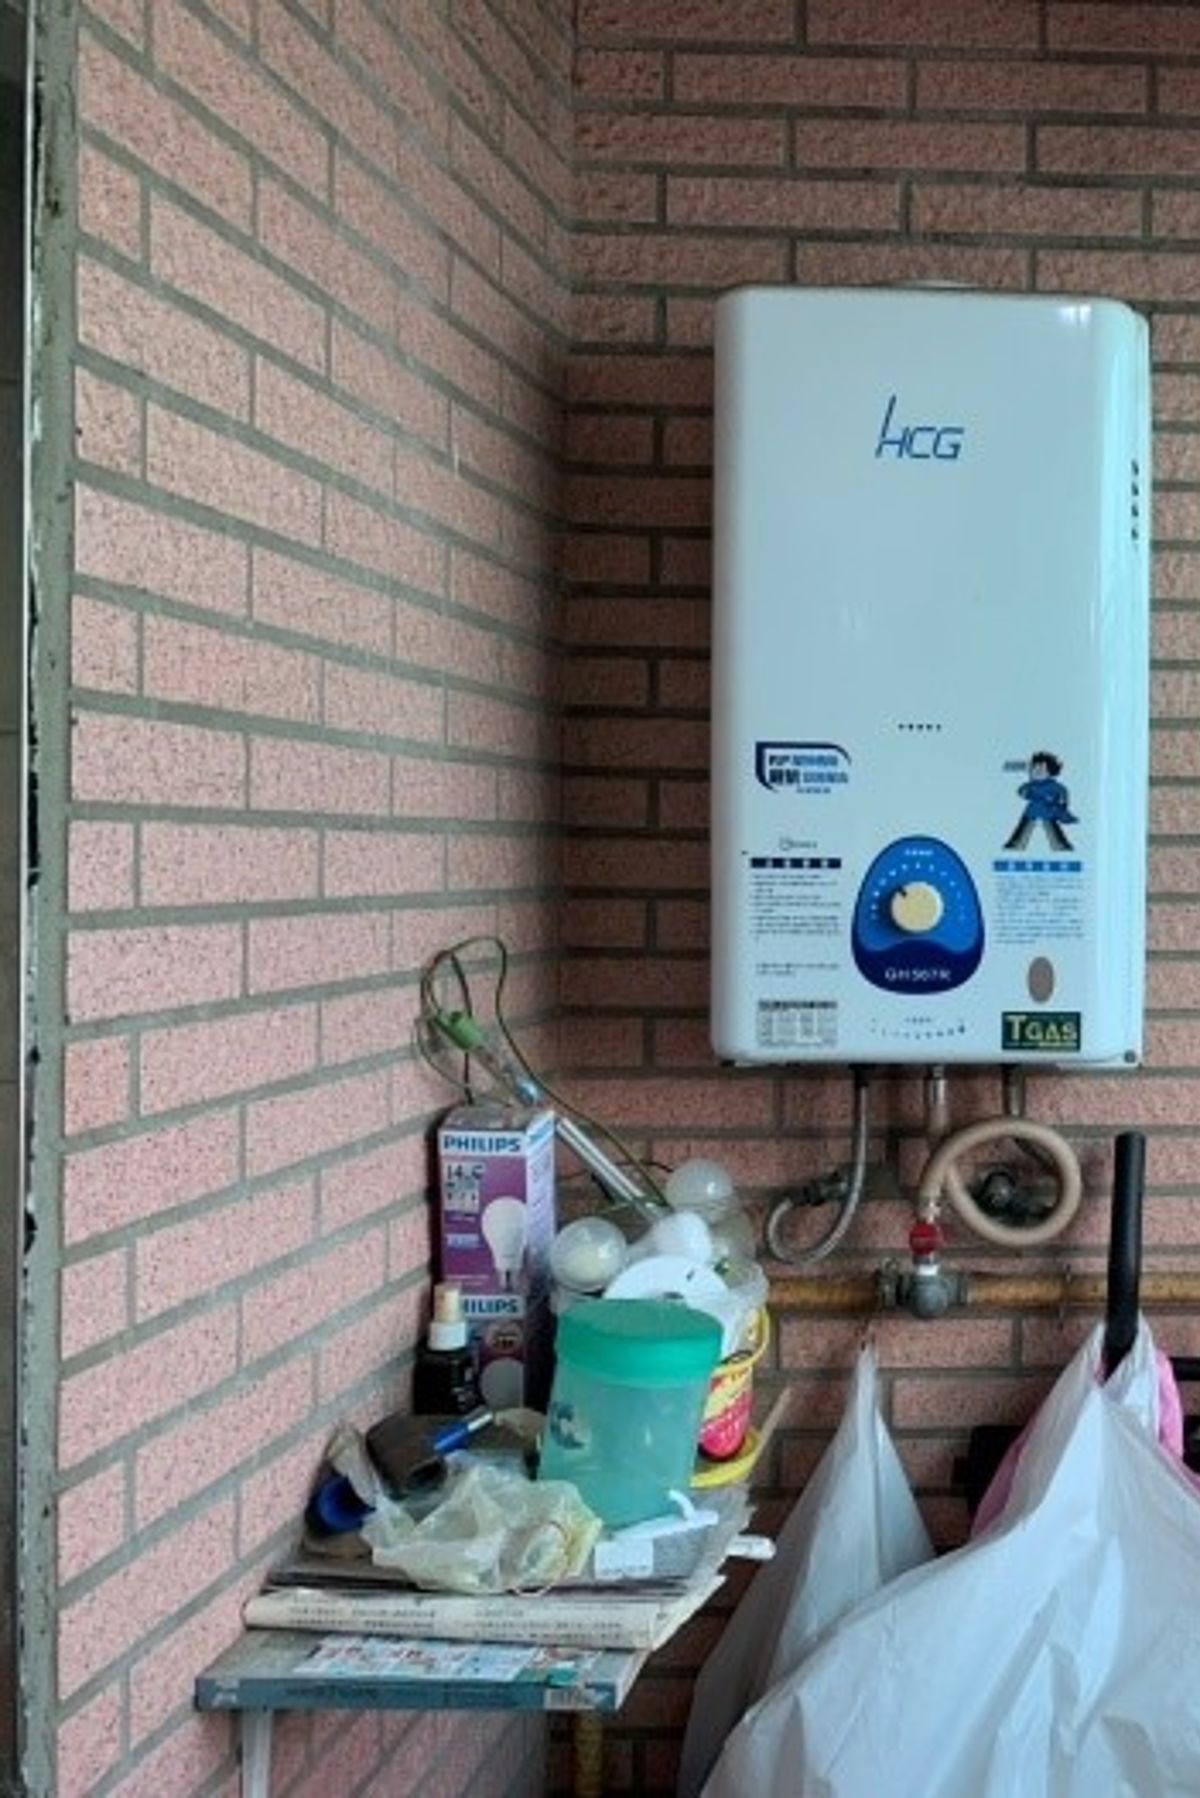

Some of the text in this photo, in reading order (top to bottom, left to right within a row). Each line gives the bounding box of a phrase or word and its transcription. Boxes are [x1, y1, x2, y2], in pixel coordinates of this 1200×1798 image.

[874, 394, 964, 459] HCG
[444, 1135, 521, 1152] PHILIPS
[462, 1298, 518, 1314] ILIPS
